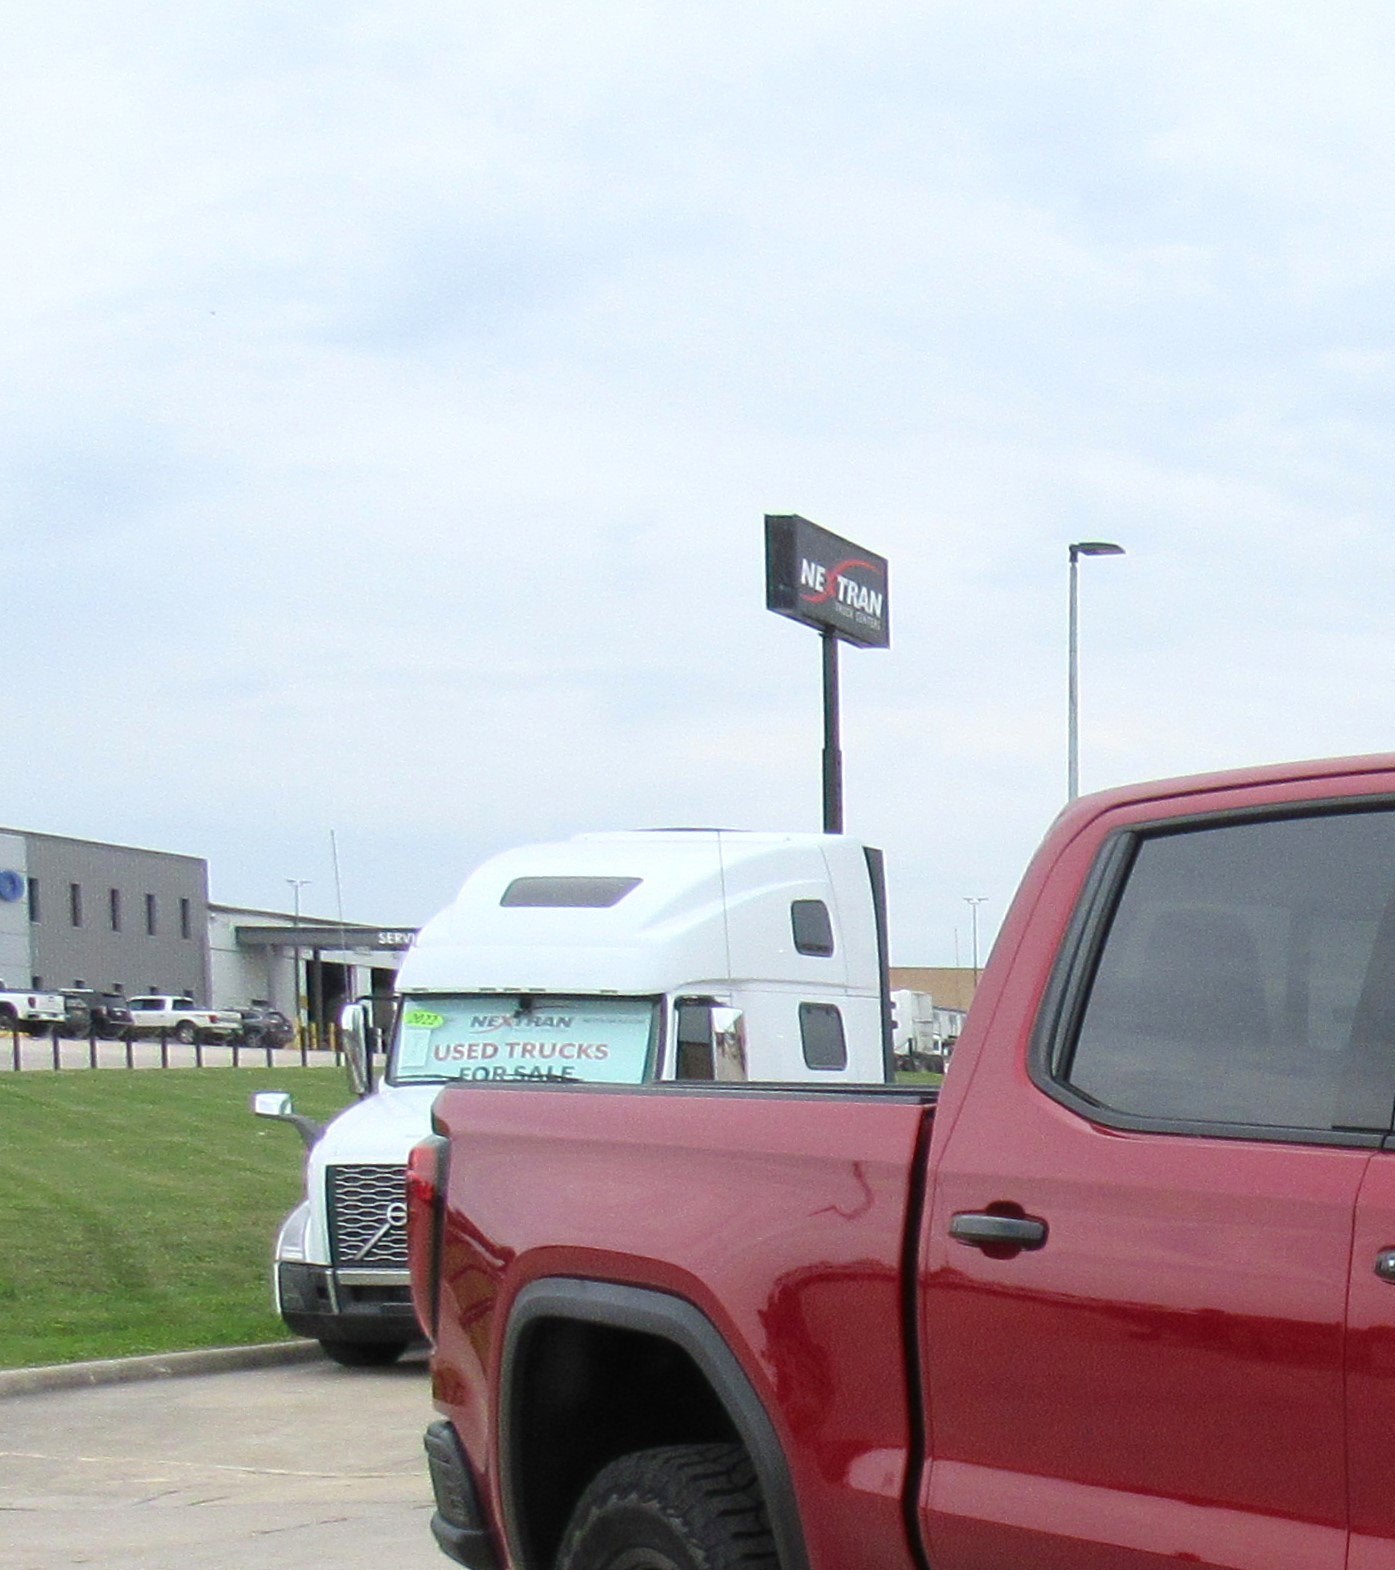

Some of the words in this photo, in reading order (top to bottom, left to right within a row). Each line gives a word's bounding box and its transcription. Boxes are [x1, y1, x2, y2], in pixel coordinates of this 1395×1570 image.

[469, 1014, 574, 1030] NEXTRAN
[433, 1042, 499, 1062] USED
[506, 1042, 609, 1061] TRUCKS
[459, 1065, 507, 1082] FOR
[513, 1065, 575, 1083] SALE
